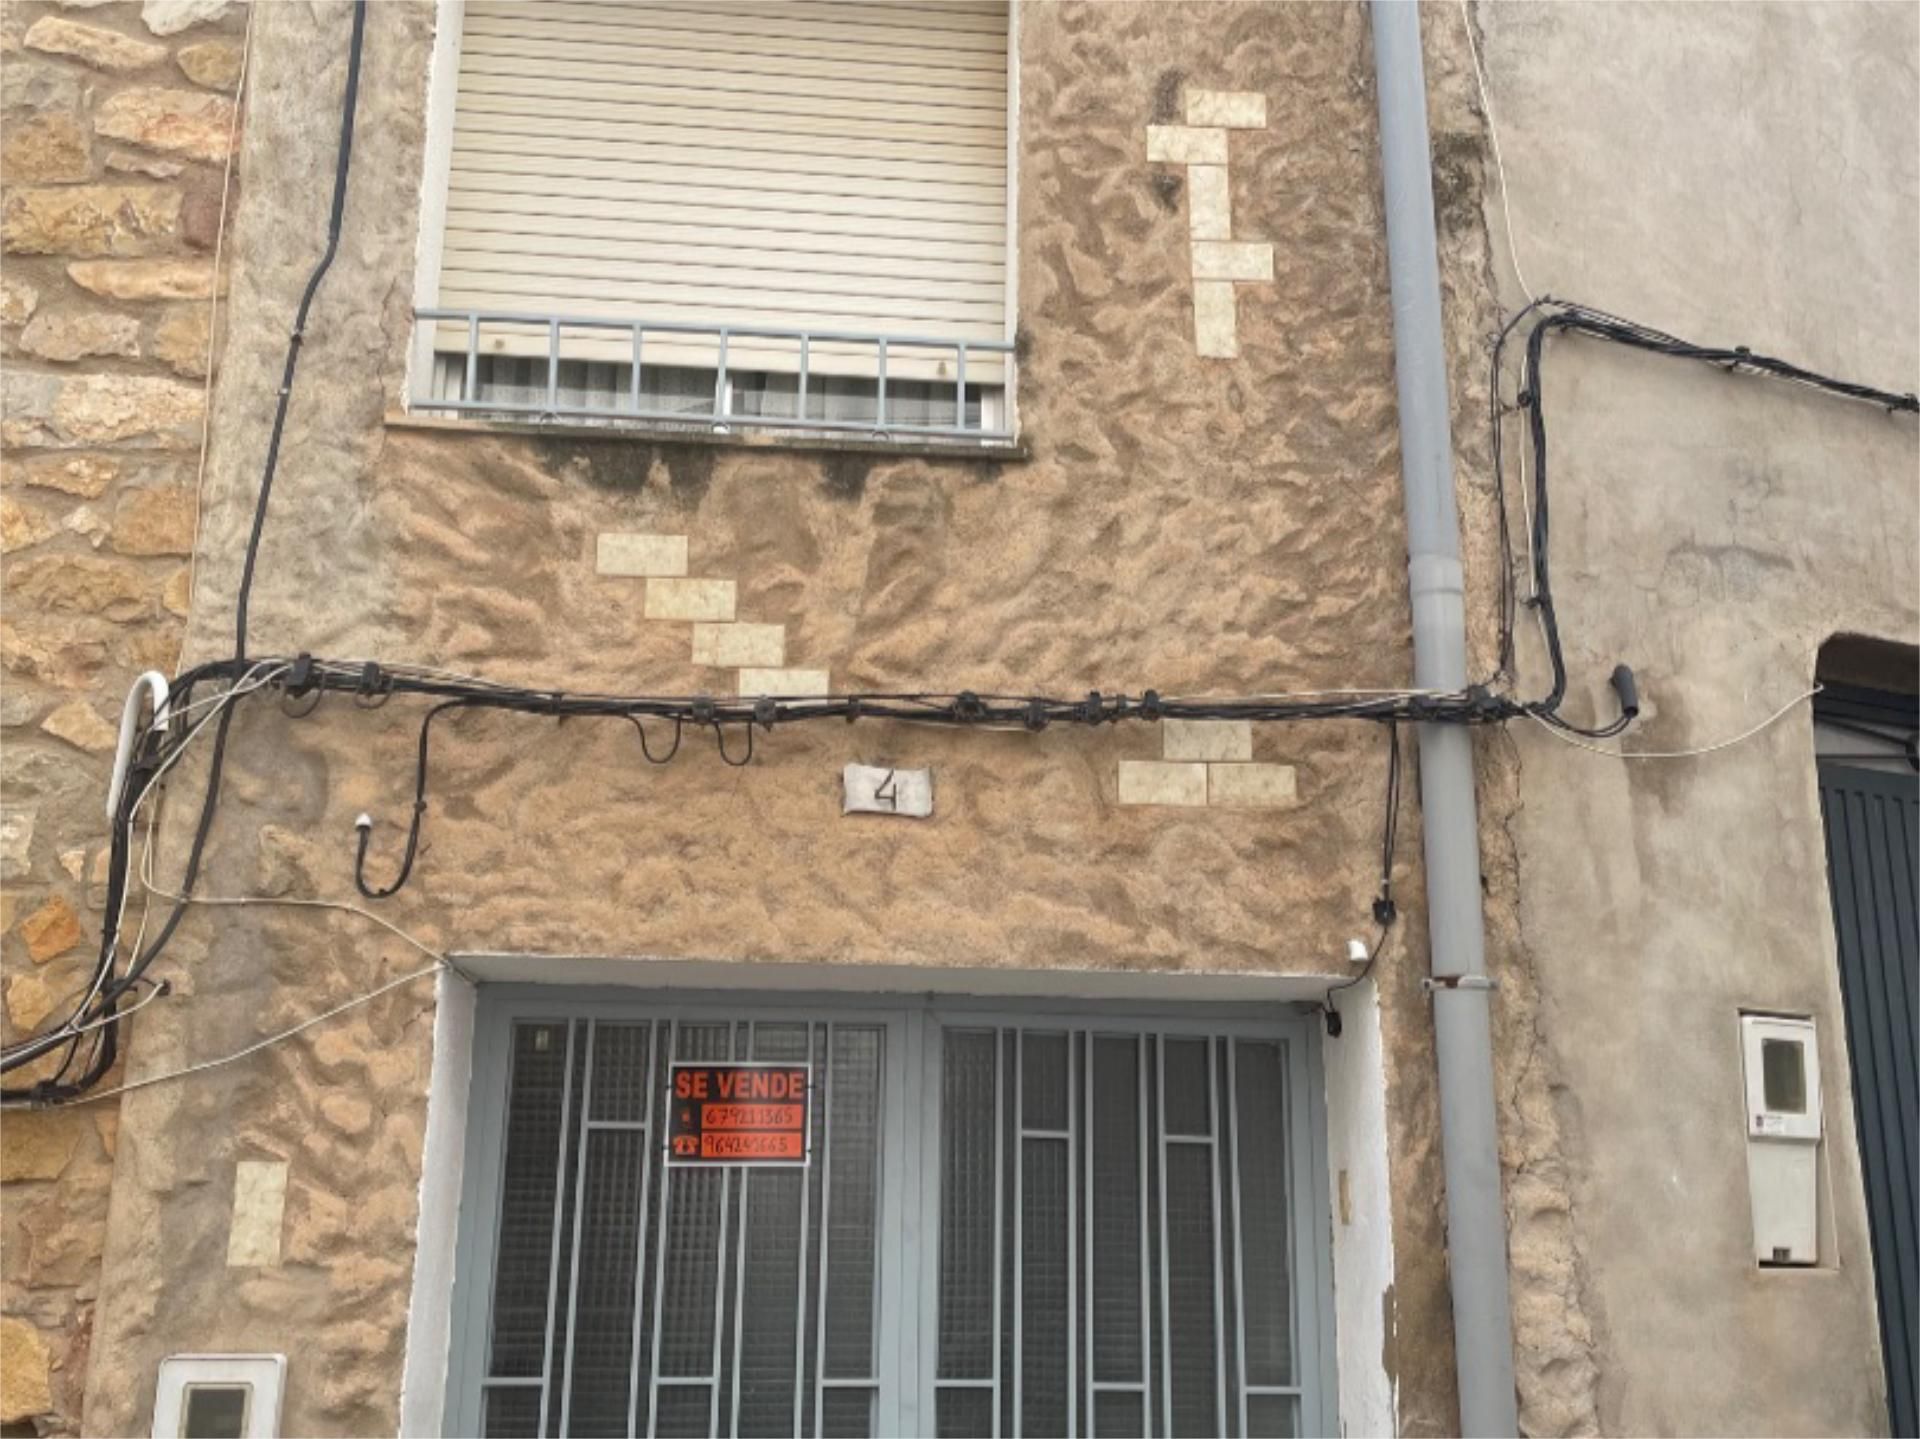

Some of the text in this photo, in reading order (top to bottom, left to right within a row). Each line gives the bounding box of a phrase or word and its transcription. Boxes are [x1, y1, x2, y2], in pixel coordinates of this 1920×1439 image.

[874, 767, 897, 811] 4
[675, 1071, 804, 1099] SE VENDE
